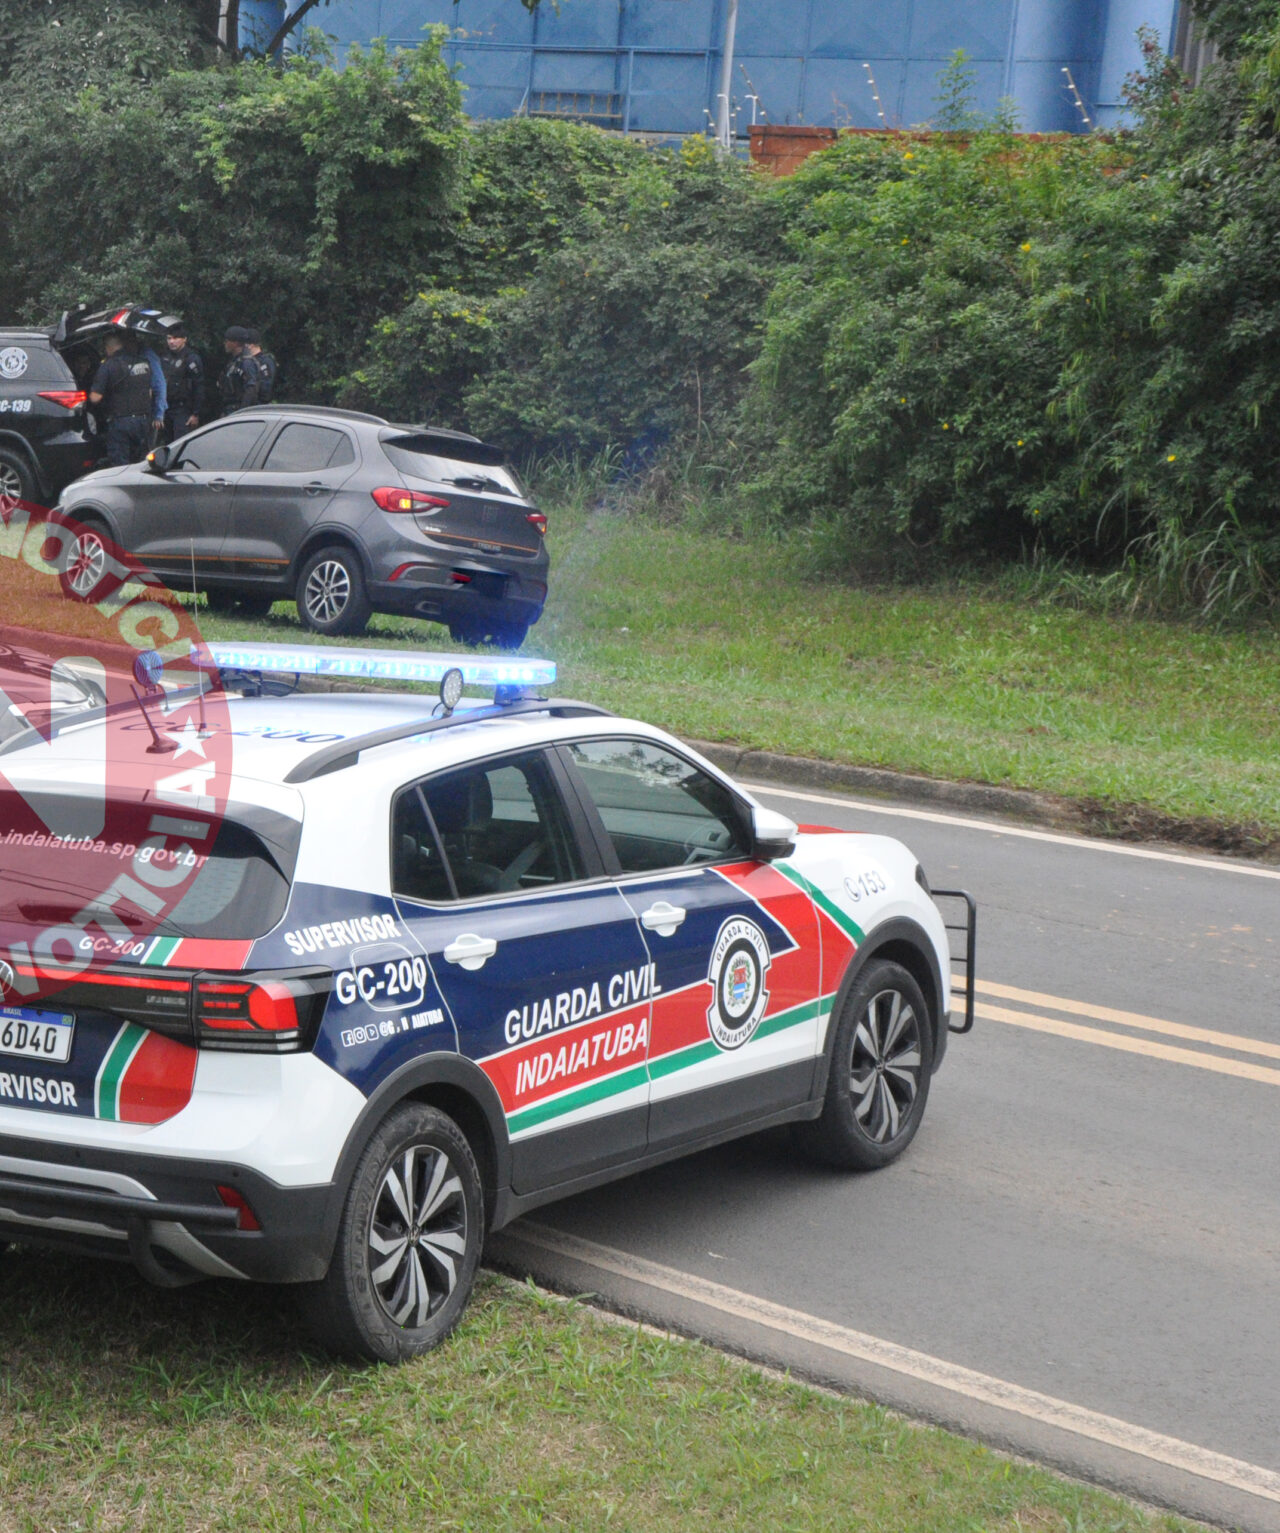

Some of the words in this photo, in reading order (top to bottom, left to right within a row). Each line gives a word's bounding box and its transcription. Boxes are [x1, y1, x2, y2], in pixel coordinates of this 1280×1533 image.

[858, 870, 886, 896] 153
[79, 935, 145, 956] GC-200
[283, 913, 402, 956] SUPERVISOR
[716, 926, 742, 961] GUARDA
[745, 926, 763, 952] CIVIL
[336, 956, 427, 1005] GC-200
[3, 1008, 23, 1017] BRASIL
[504, 982, 601, 1044] GUARDA
[608, 962, 662, 1008] CIVIL
[716, 1017, 757, 1042] INDAIATUBA
[515, 1018, 648, 1096] INDAIATUBA
